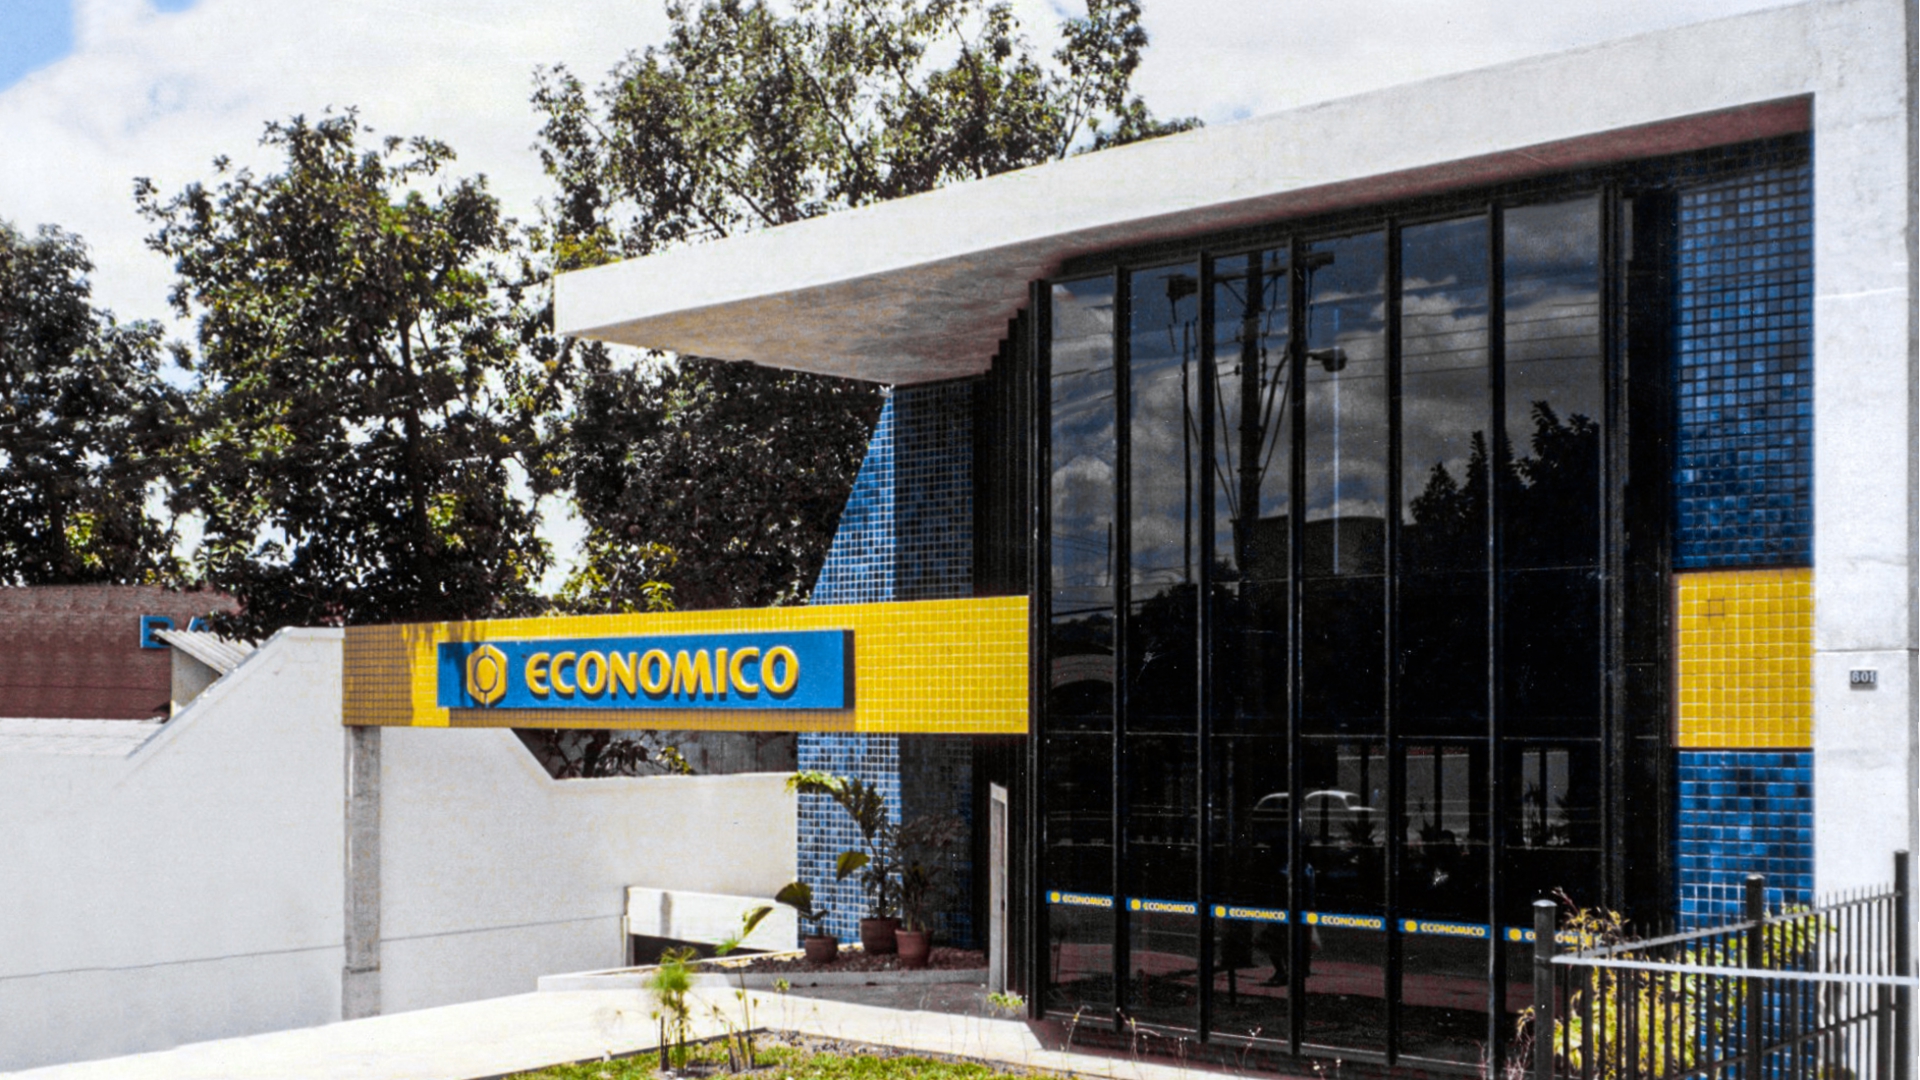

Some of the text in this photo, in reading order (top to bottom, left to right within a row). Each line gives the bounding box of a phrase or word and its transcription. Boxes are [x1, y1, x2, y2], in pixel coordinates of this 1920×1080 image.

[525, 645, 799, 694] ECONOMICO
[1851, 671, 1877, 683] 801
[1062, 893, 1112, 907] ECONOMICO
[1142, 902, 1196, 914] ECONOMICO
[1229, 907, 1286, 920] ECONOMICO
[1320, 915, 1382, 929] ECONOMICO
[1420, 922, 1485, 937] ECONOMICO
